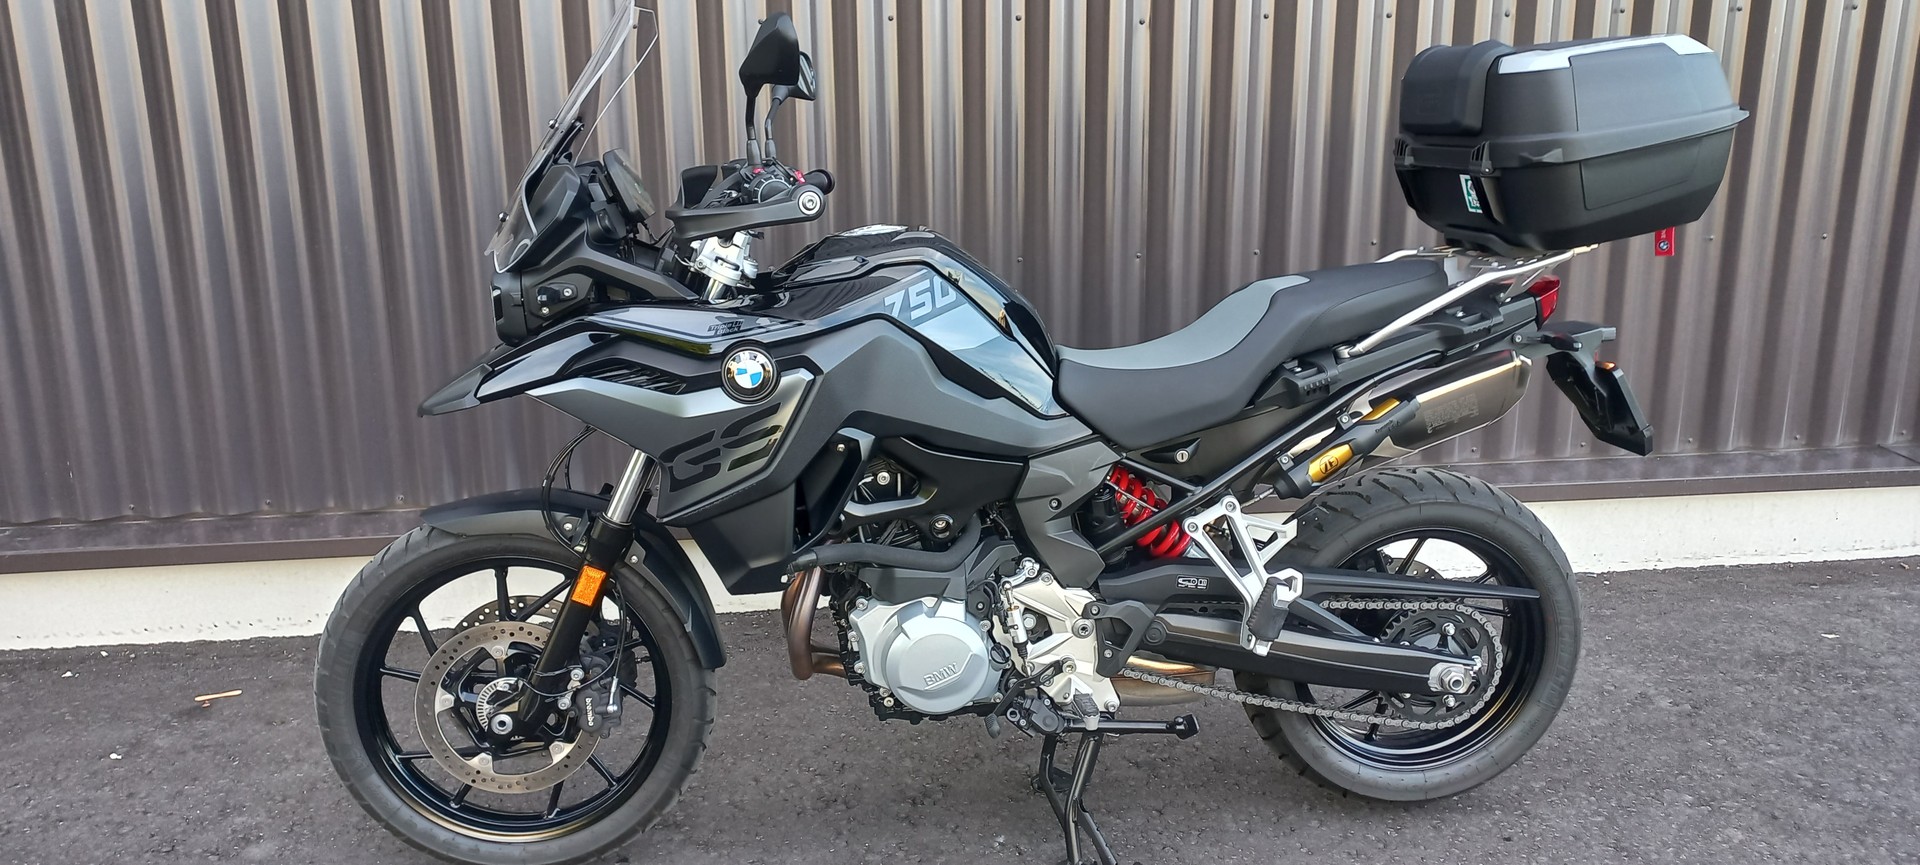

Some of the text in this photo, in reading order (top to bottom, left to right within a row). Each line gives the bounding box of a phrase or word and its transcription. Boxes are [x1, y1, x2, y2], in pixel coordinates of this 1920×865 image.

[884, 275, 957, 320] 750
[710, 323, 733, 331] Triple
[717, 326, 740, 335] Black
[658, 402, 784, 492] GS
[923, 662, 957, 687] BMW
[585, 697, 595, 726] brembo
